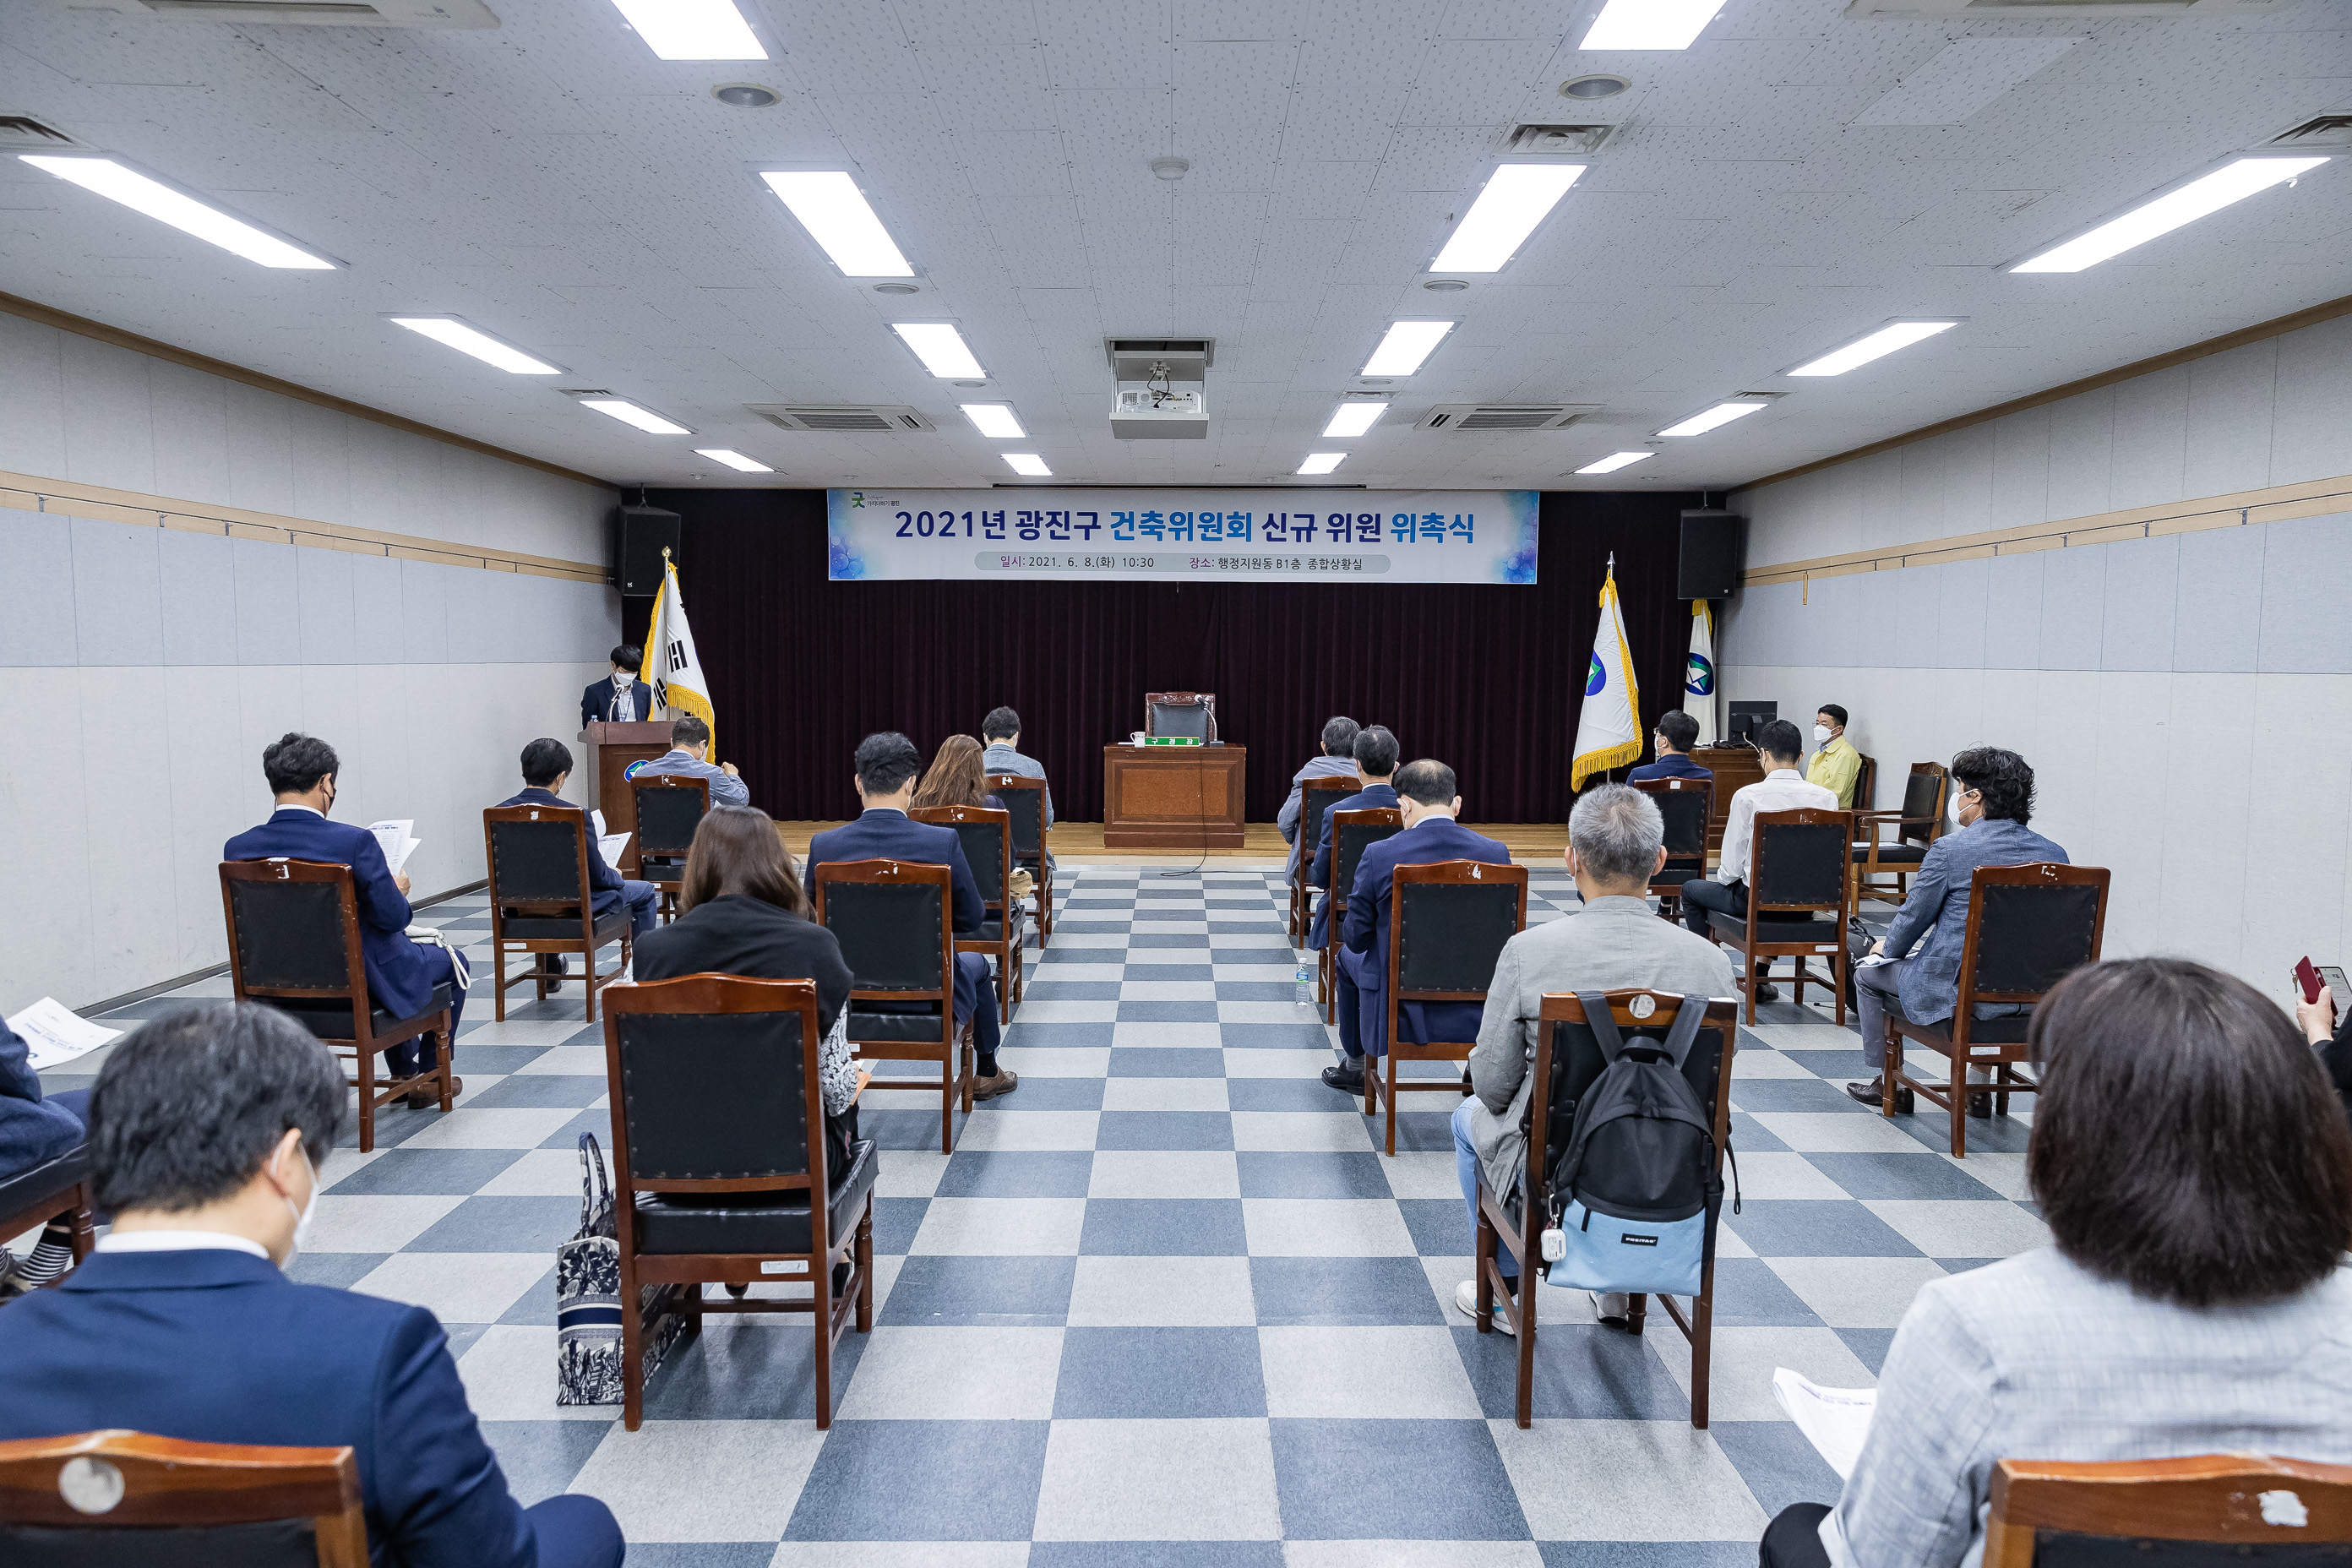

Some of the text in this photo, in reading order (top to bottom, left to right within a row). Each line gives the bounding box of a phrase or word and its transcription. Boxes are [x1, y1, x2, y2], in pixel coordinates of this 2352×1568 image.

[896, 510, 1473, 543] 2021년 광진구 건축위원회 신규 위원 위촉식
[1000, 555, 1026, 568] 일시:
[1028, 557, 1061, 568] 2021.
[1067, 557, 1078, 568] 6.
[1122, 557, 1154, 568] 10:30
[1189, 558, 1363, 571] 장소: 행정지원동 B1층 종합상황실
